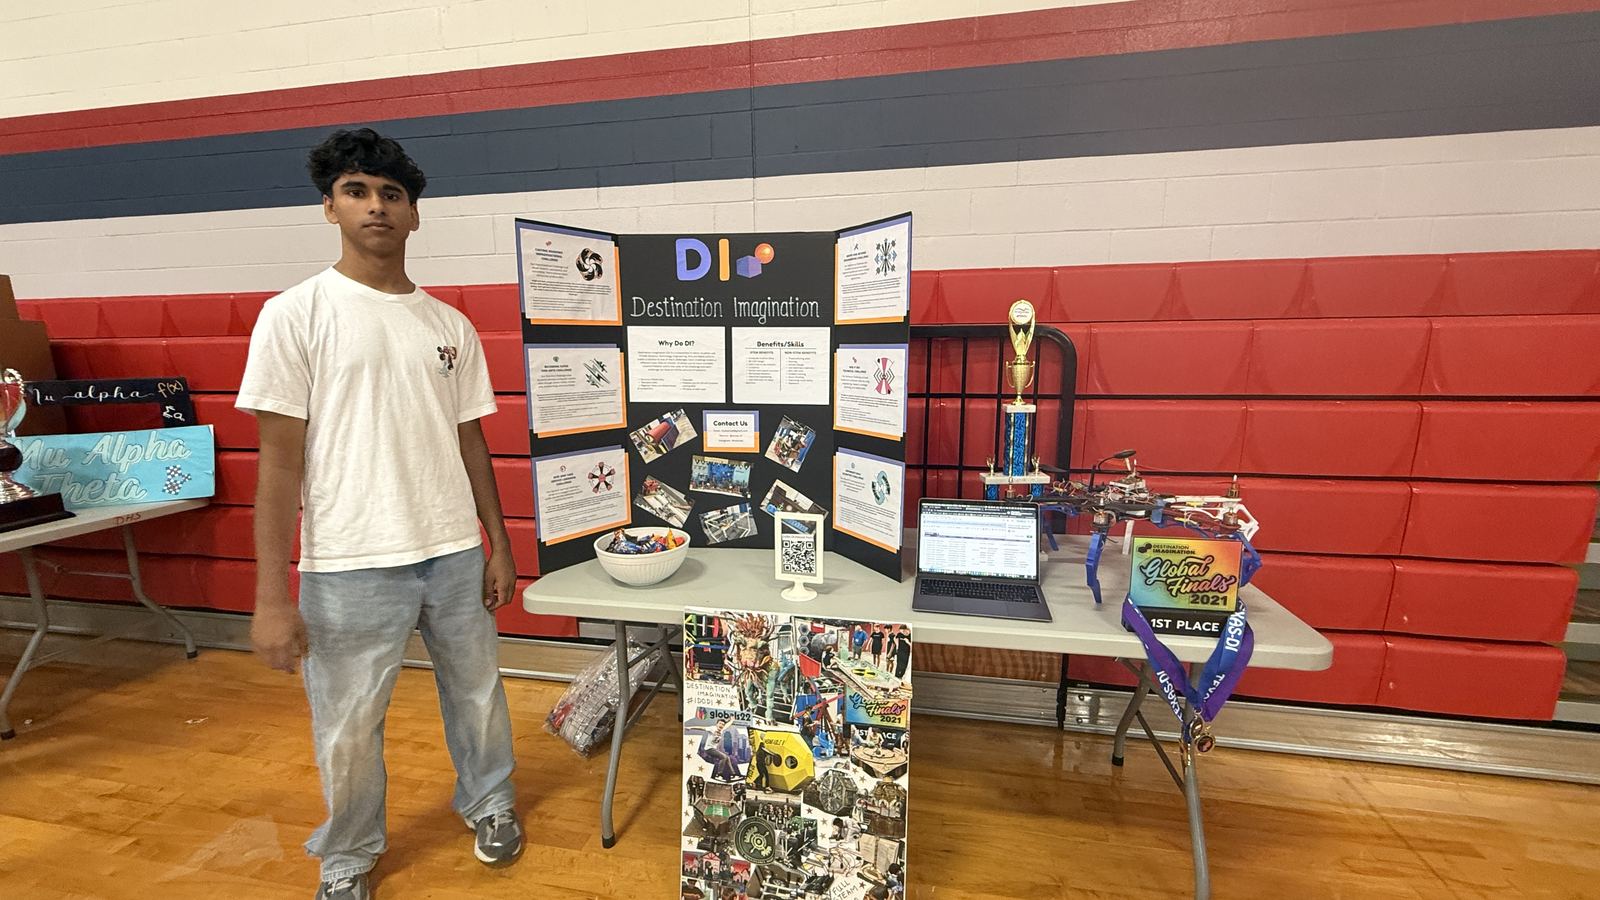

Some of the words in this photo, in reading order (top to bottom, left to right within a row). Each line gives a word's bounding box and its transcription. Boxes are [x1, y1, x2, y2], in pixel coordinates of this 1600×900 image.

[675, 238, 731, 281] DI
[630, 296, 723, 318] Destination
[733, 296, 820, 324] Imagination
[63, 385, 154, 402] alpha
[81, 430, 192, 474] Alpha
[33, 472, 148, 504] Theta
[113, 512, 142, 527] DHS
[1139, 554, 1215, 586] Global
[1165, 573, 1238, 598] Finals
[1190, 594, 1229, 606] 2021
[1151, 618, 1172, 629] 1ST
[1176, 621, 1220, 632] PLACE
[686, 682, 731, 692] DESTINATION
[865, 703, 907, 717] Finals
[832, 880, 851, 895] FULL
